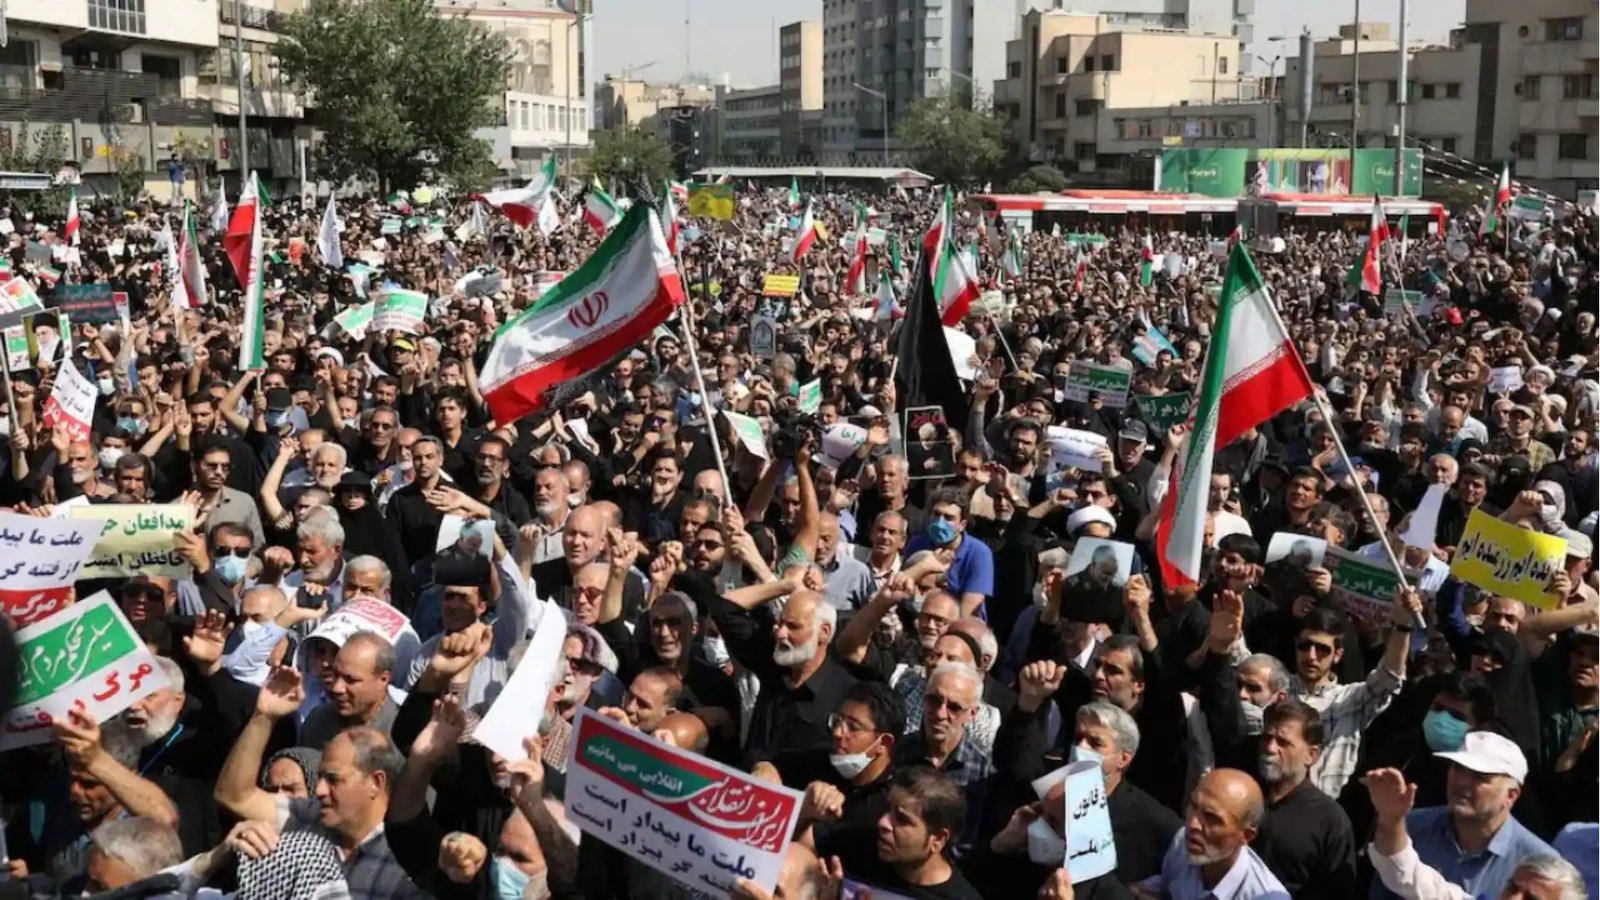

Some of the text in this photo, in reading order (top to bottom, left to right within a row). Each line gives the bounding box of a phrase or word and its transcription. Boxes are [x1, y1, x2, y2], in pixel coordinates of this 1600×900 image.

[100, 512, 185, 536] مدافعان حر
[0, 528, 83, 547] ملت ما بید
[28, 560, 60, 576] فتنه
[59, 560, 81, 580] از
[83, 551, 185, 570] حافظان امنیت
[10, 591, 57, 621] مرگ
[31, 645, 66, 685] مردم
[93, 663, 153, 702] مرگ
[617, 760, 637, 773] می
[639, 770, 683, 793] انقلابی
[571, 802, 613, 831] است
[584, 782, 756, 880] ملت ما بیدار است
[618, 831, 663, 863] بیزار
